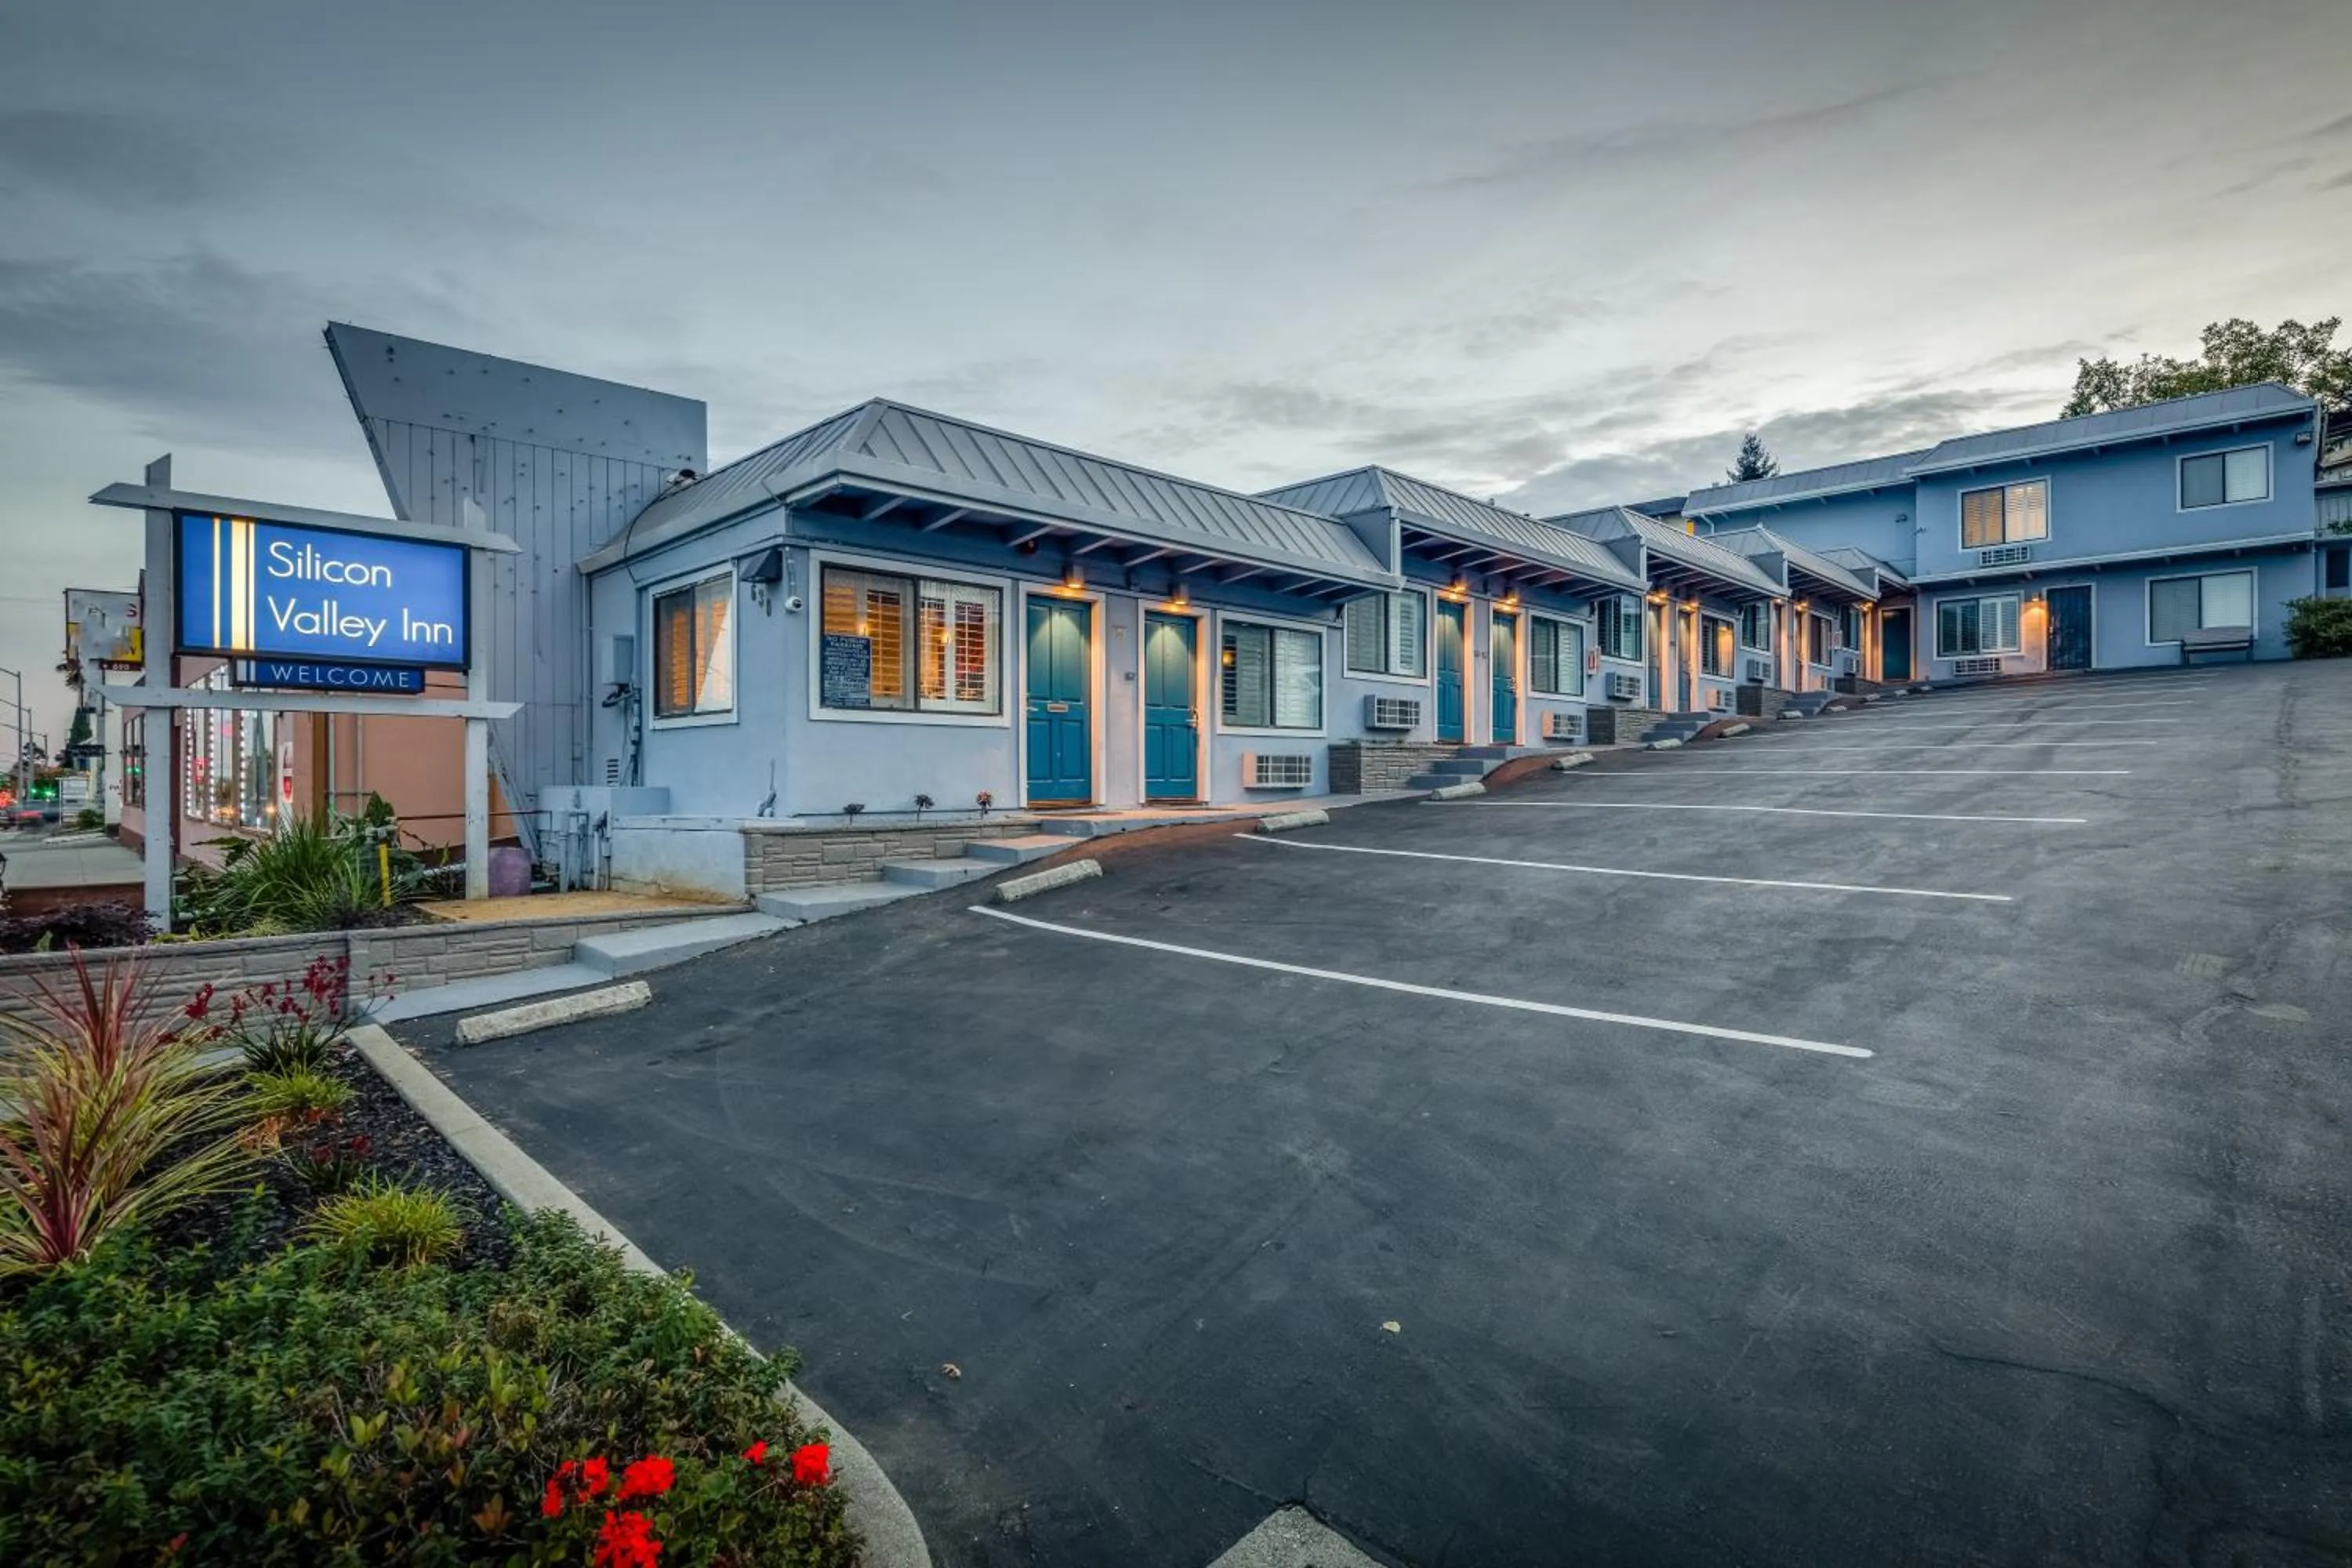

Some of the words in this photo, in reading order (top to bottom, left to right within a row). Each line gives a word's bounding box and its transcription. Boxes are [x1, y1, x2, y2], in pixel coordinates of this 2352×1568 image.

[267, 541, 391, 588] Silicon
[267, 595, 387, 647] Valley
[403, 608, 452, 644] Inn
[271, 664, 410, 688] WELCOME
